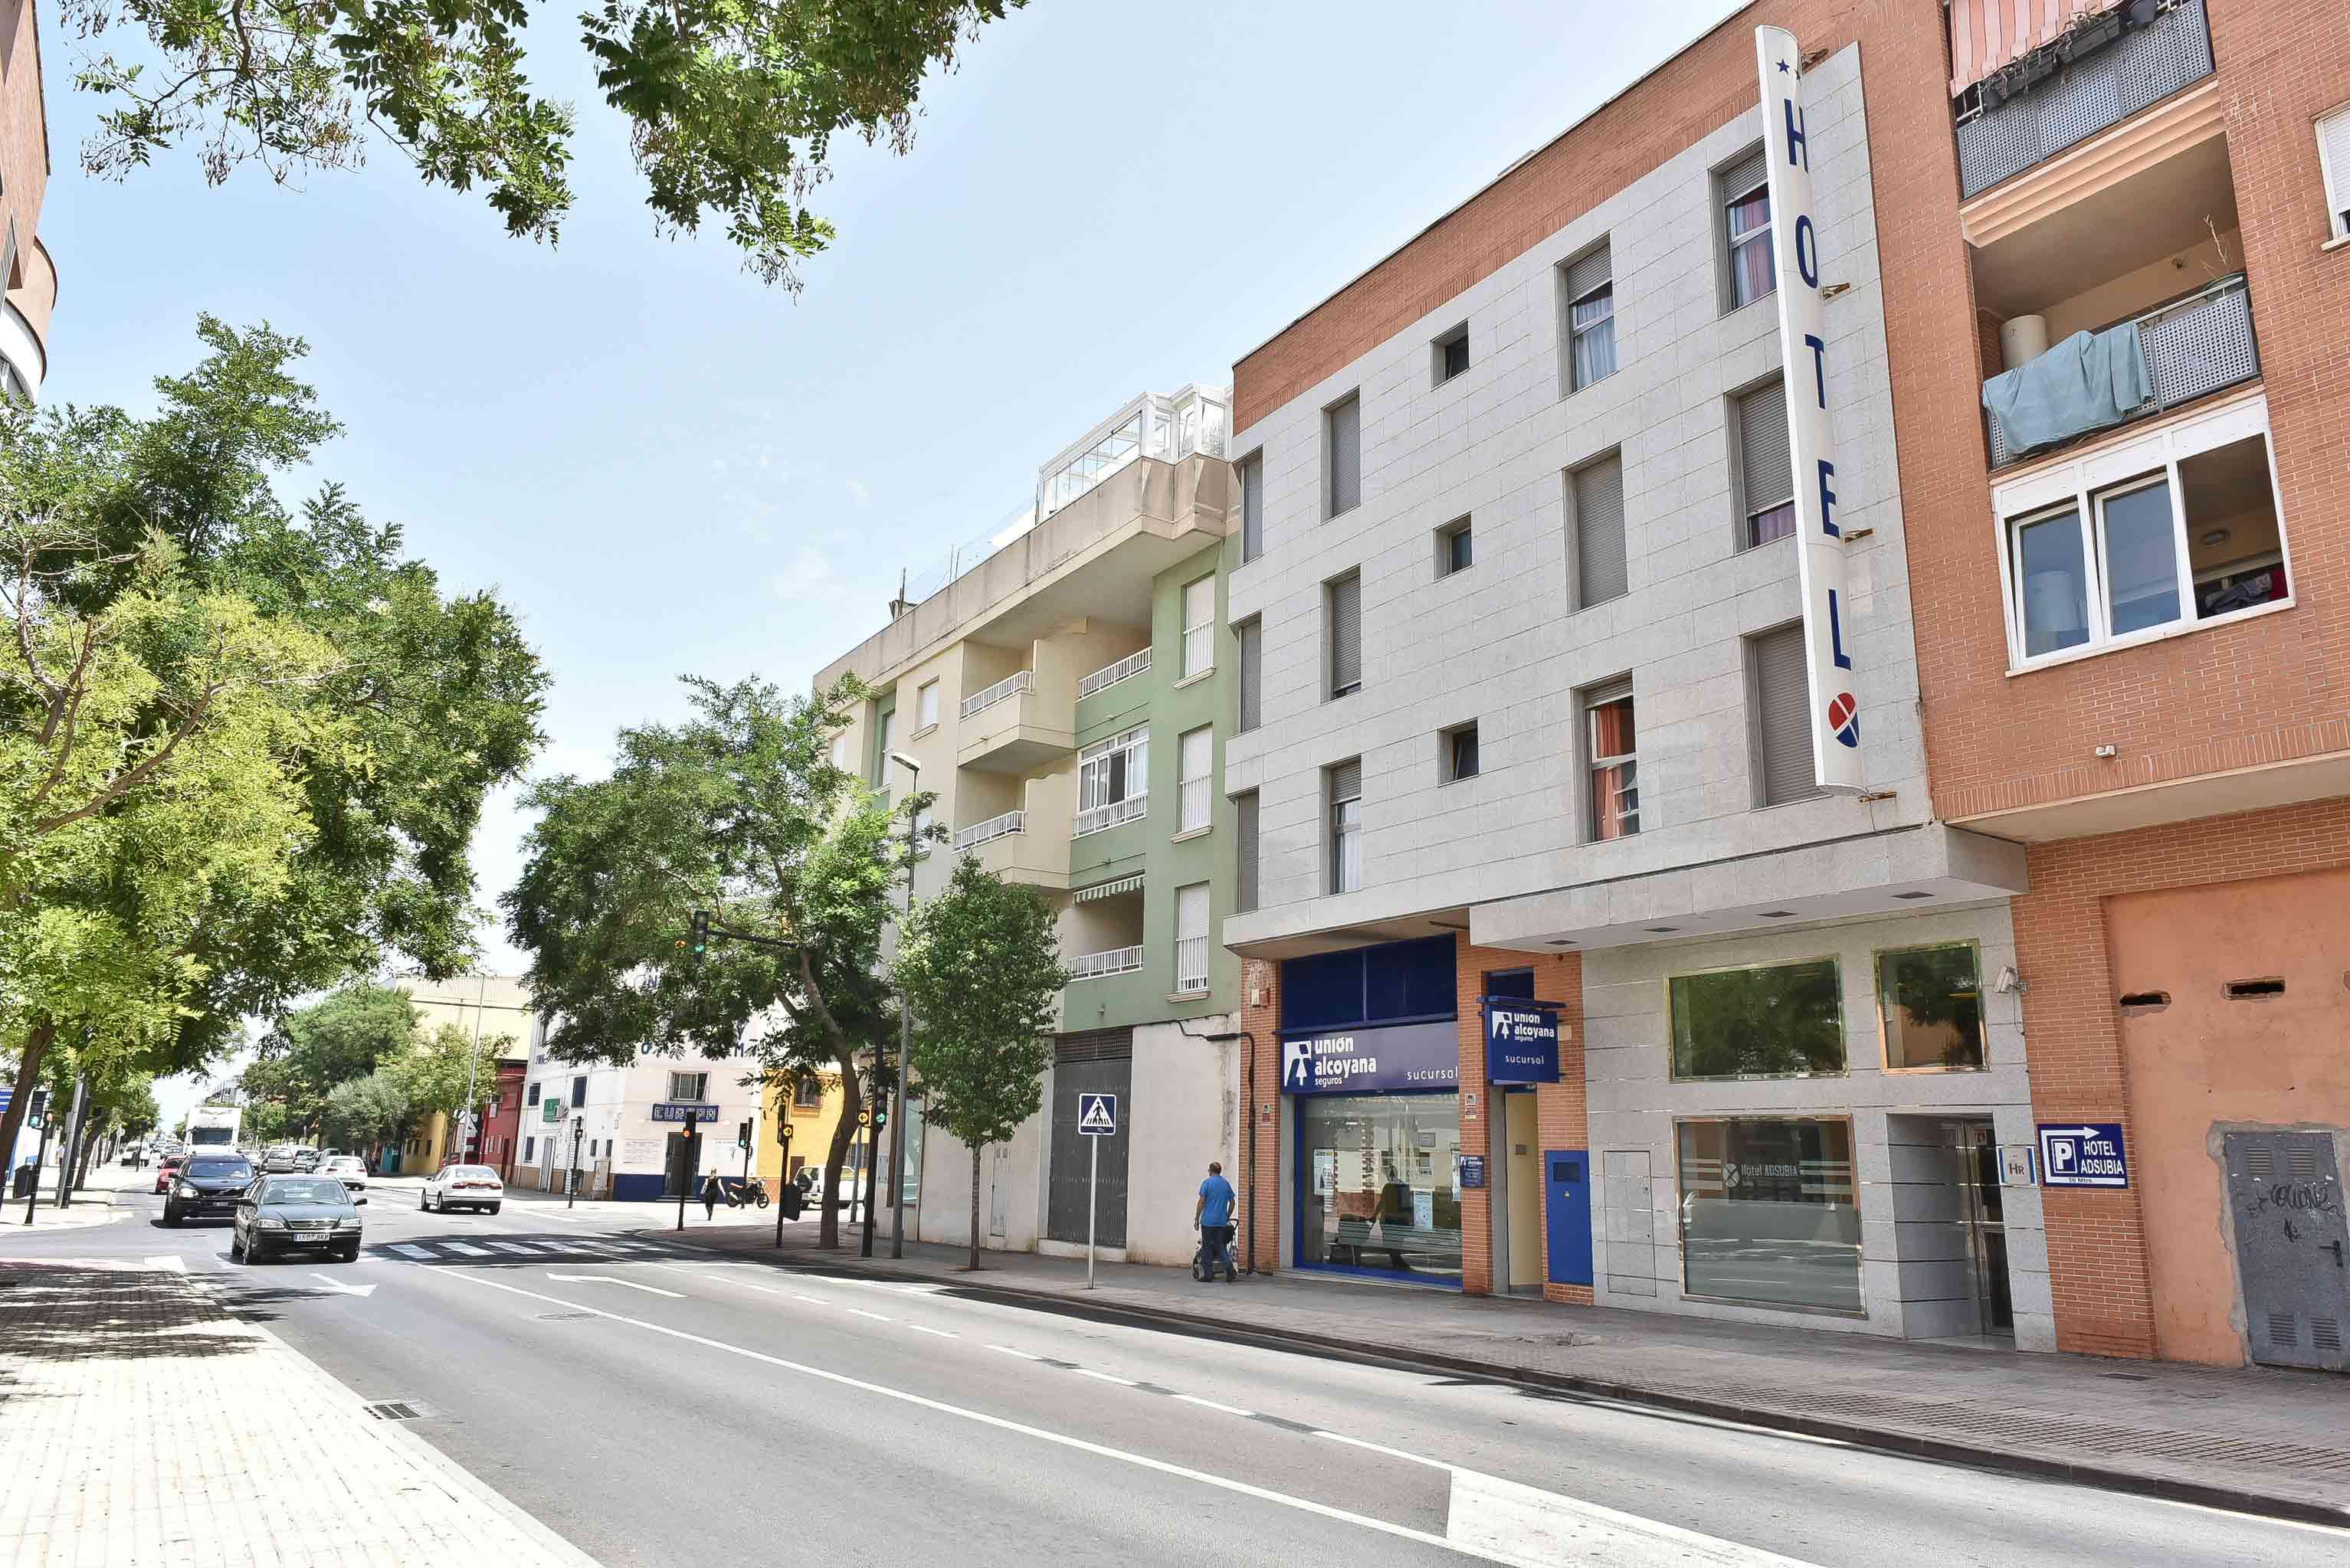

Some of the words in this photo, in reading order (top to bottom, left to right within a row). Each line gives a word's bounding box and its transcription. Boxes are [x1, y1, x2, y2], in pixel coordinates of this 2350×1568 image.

[1784, 98, 1852, 671] HOTEL
[1514, 1023, 1555, 1039] alcoyana
[1314, 1056, 1377, 1079] alcoyana
[1505, 1055, 1545, 1066] sucursal
[1407, 1066, 1458, 1081] sucursal
[1314, 1076, 1342, 1088] seguros
[2053, 1142, 2073, 1170] P
[2083, 1141, 2116, 1157] HOTEL
[1741, 1164, 1762, 1177] Hotel
[1765, 1164, 1798, 1177] ADSUBIA
[2080, 1158, 2125, 1175] ADSUBIA
